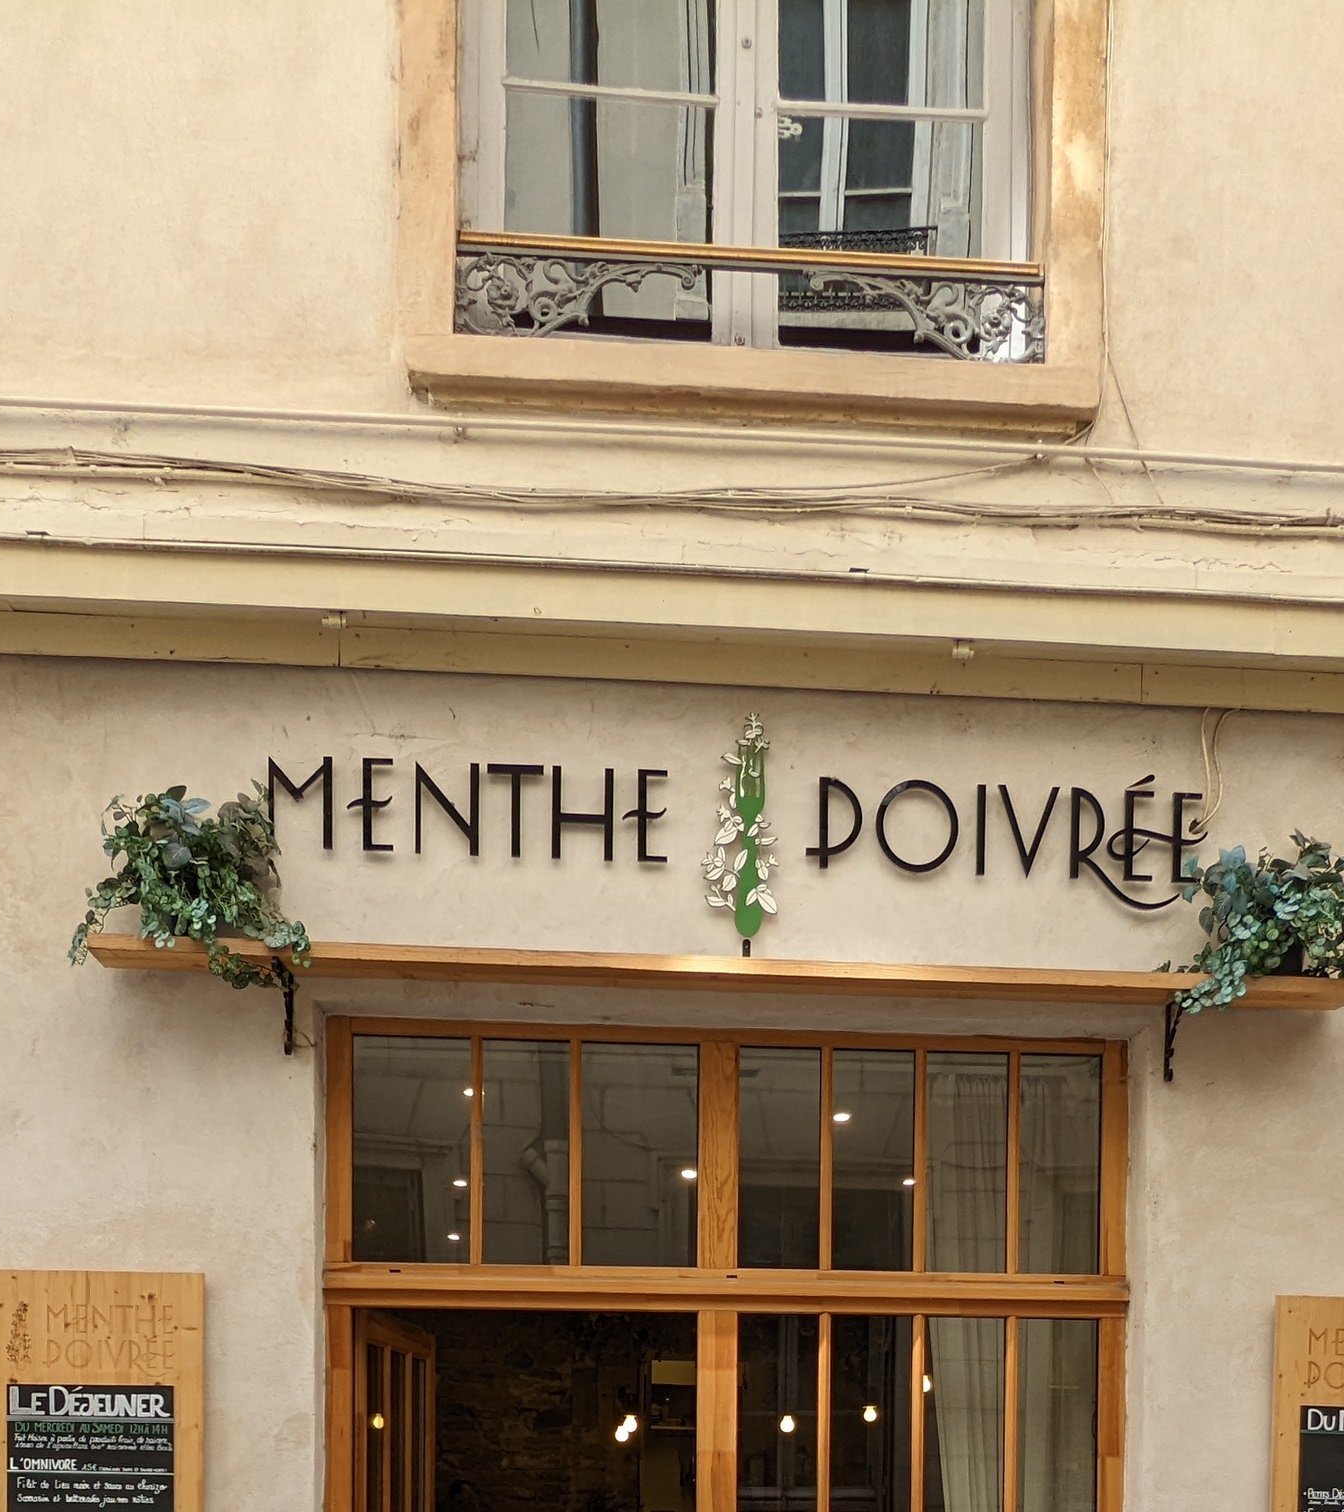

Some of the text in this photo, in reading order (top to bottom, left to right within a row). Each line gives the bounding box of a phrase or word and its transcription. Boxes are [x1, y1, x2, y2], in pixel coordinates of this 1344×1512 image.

[267, 755, 1207, 909] MENTHE POIVRÉE
[47, 1304, 175, 1334] MENTHE
[43, 1336, 175, 1377] POIVRÉE
[9, 1386, 171, 1417] LE DÉJEUNER
[15, 1422, 30, 1432] DU
[34, 1422, 75, 1433] MERCREDI
[79, 1423, 90, 1433] AU
[92, 1422, 123, 1434] SAMEDI
[9, 1457, 78, 1470] L'OMNIVORE
[16, 1477, 38, 1489] Filet
[40, 1479, 49, 1489] de
[94, 1480, 101, 1490] et
[53, 1493, 61, 1503] et
